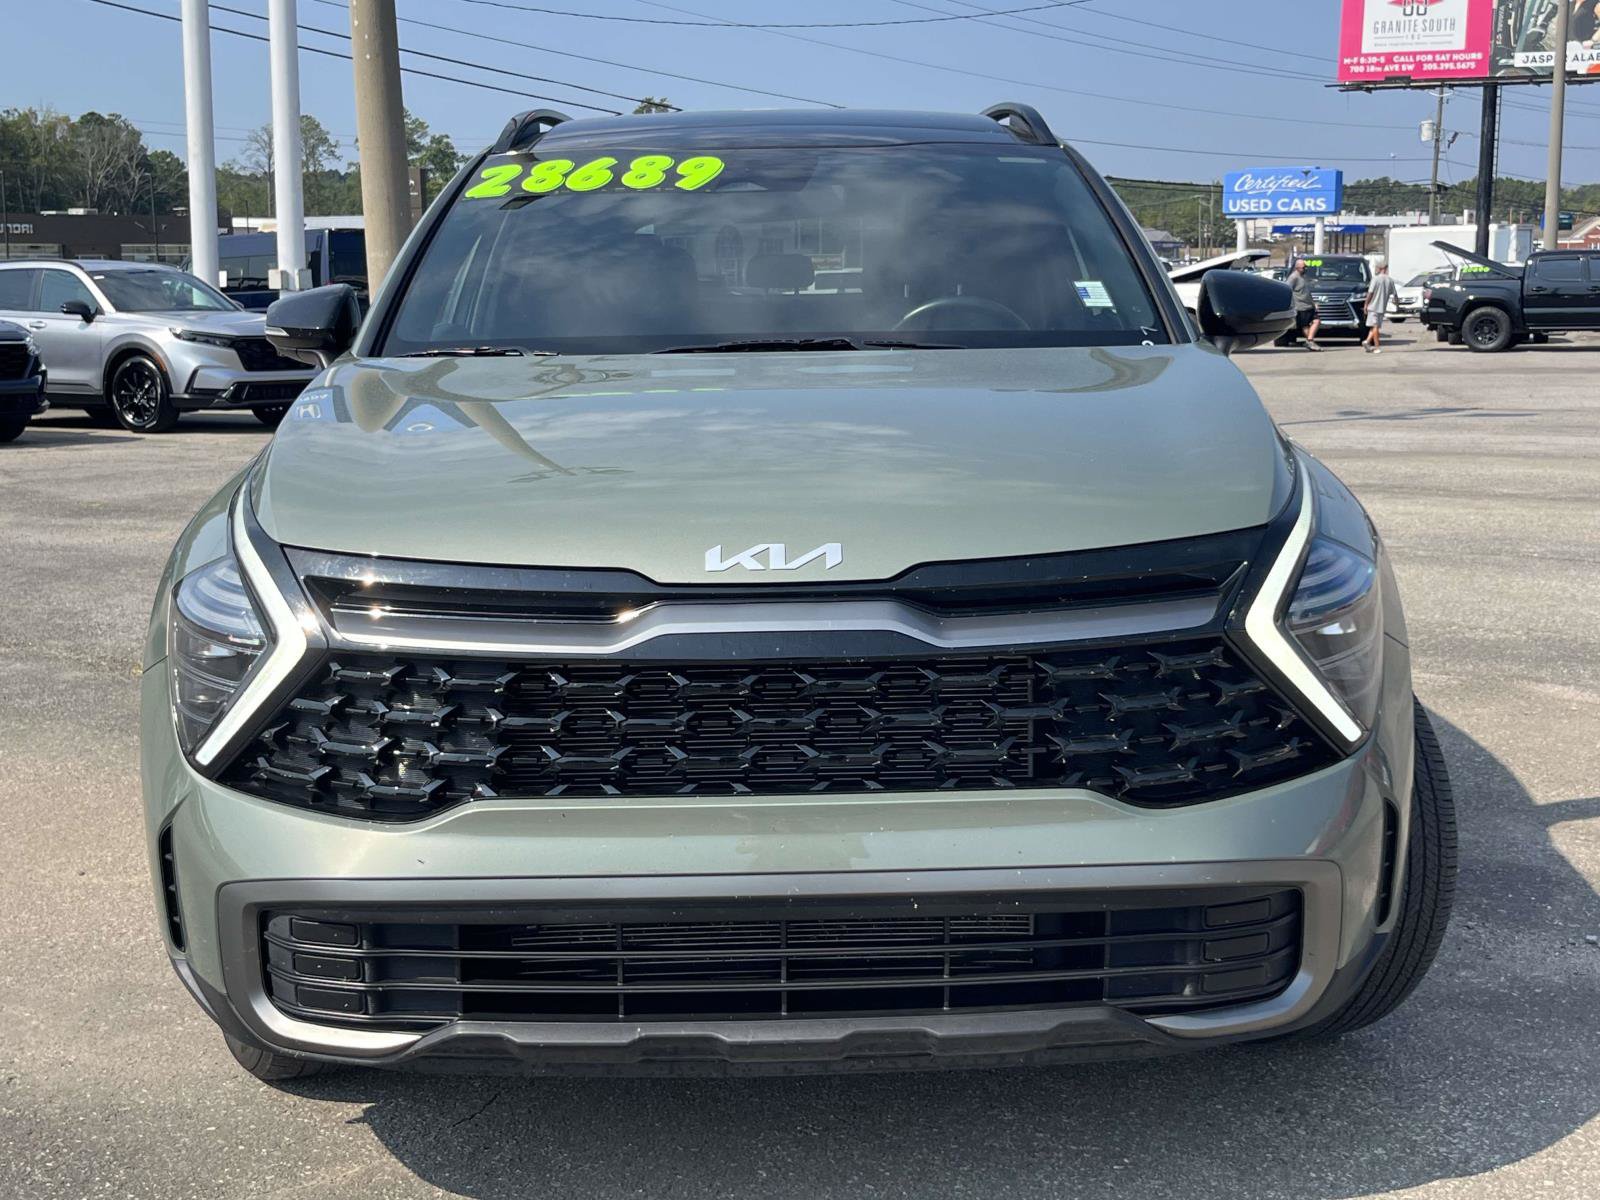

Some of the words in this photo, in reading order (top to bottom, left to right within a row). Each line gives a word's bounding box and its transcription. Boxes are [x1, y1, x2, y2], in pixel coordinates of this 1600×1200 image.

[1373, 19, 1419, 34] GRANITE
[1422, 17, 1456, 33] SOUTH
[1392, 55, 1415, 63] CALL
[1416, 54, 1433, 62] FOR
[1435, 53, 1451, 62] SAT
[1452, 52, 1483, 61] HOURS
[1349, 65, 1365, 73] 700
[1383, 64, 1400, 72] AVE
[1401, 63, 1415, 71] SW
[465, 155, 725, 199] 28689
[1234, 173, 1322, 196] Certified
[1228, 199, 1273, 212] USED
[1276, 197, 1327, 211] CARS
[705, 543, 844, 572] KIA
